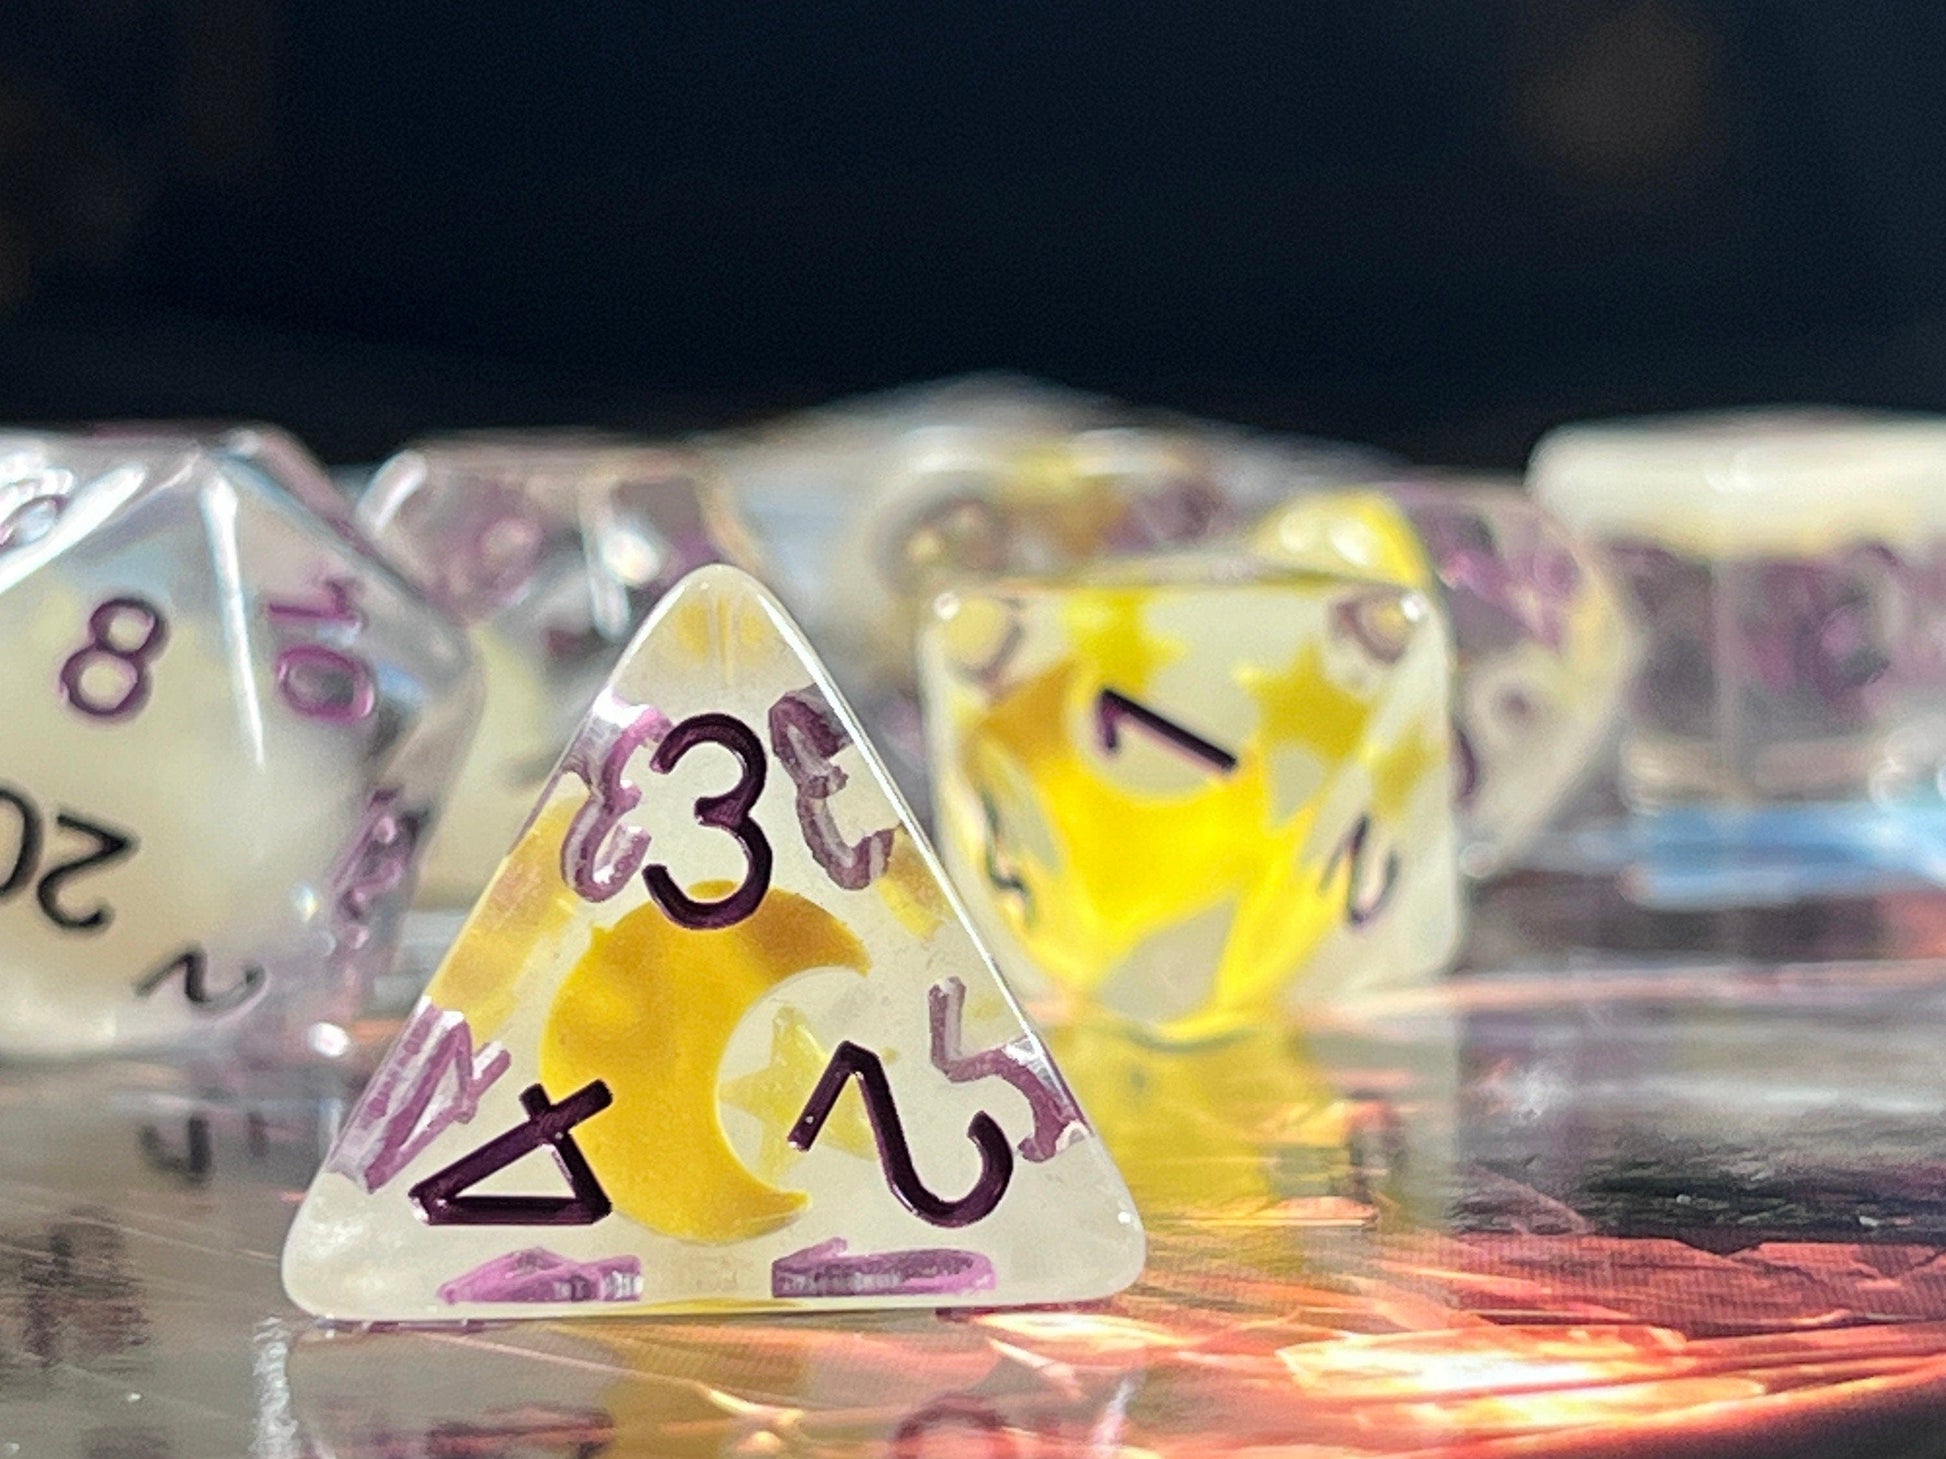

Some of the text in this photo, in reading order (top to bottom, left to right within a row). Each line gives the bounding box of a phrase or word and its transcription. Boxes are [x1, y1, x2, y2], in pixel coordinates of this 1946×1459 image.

[60, 595, 166, 720] 8
[264, 575, 378, 724] 10
[1096, 689, 1237, 770] 1
[643, 713, 772, 930] 3
[133, 948, 266, 1014] 2
[408, 1078, 614, 1226] 4
[787, 1040, 1014, 1228] 2
